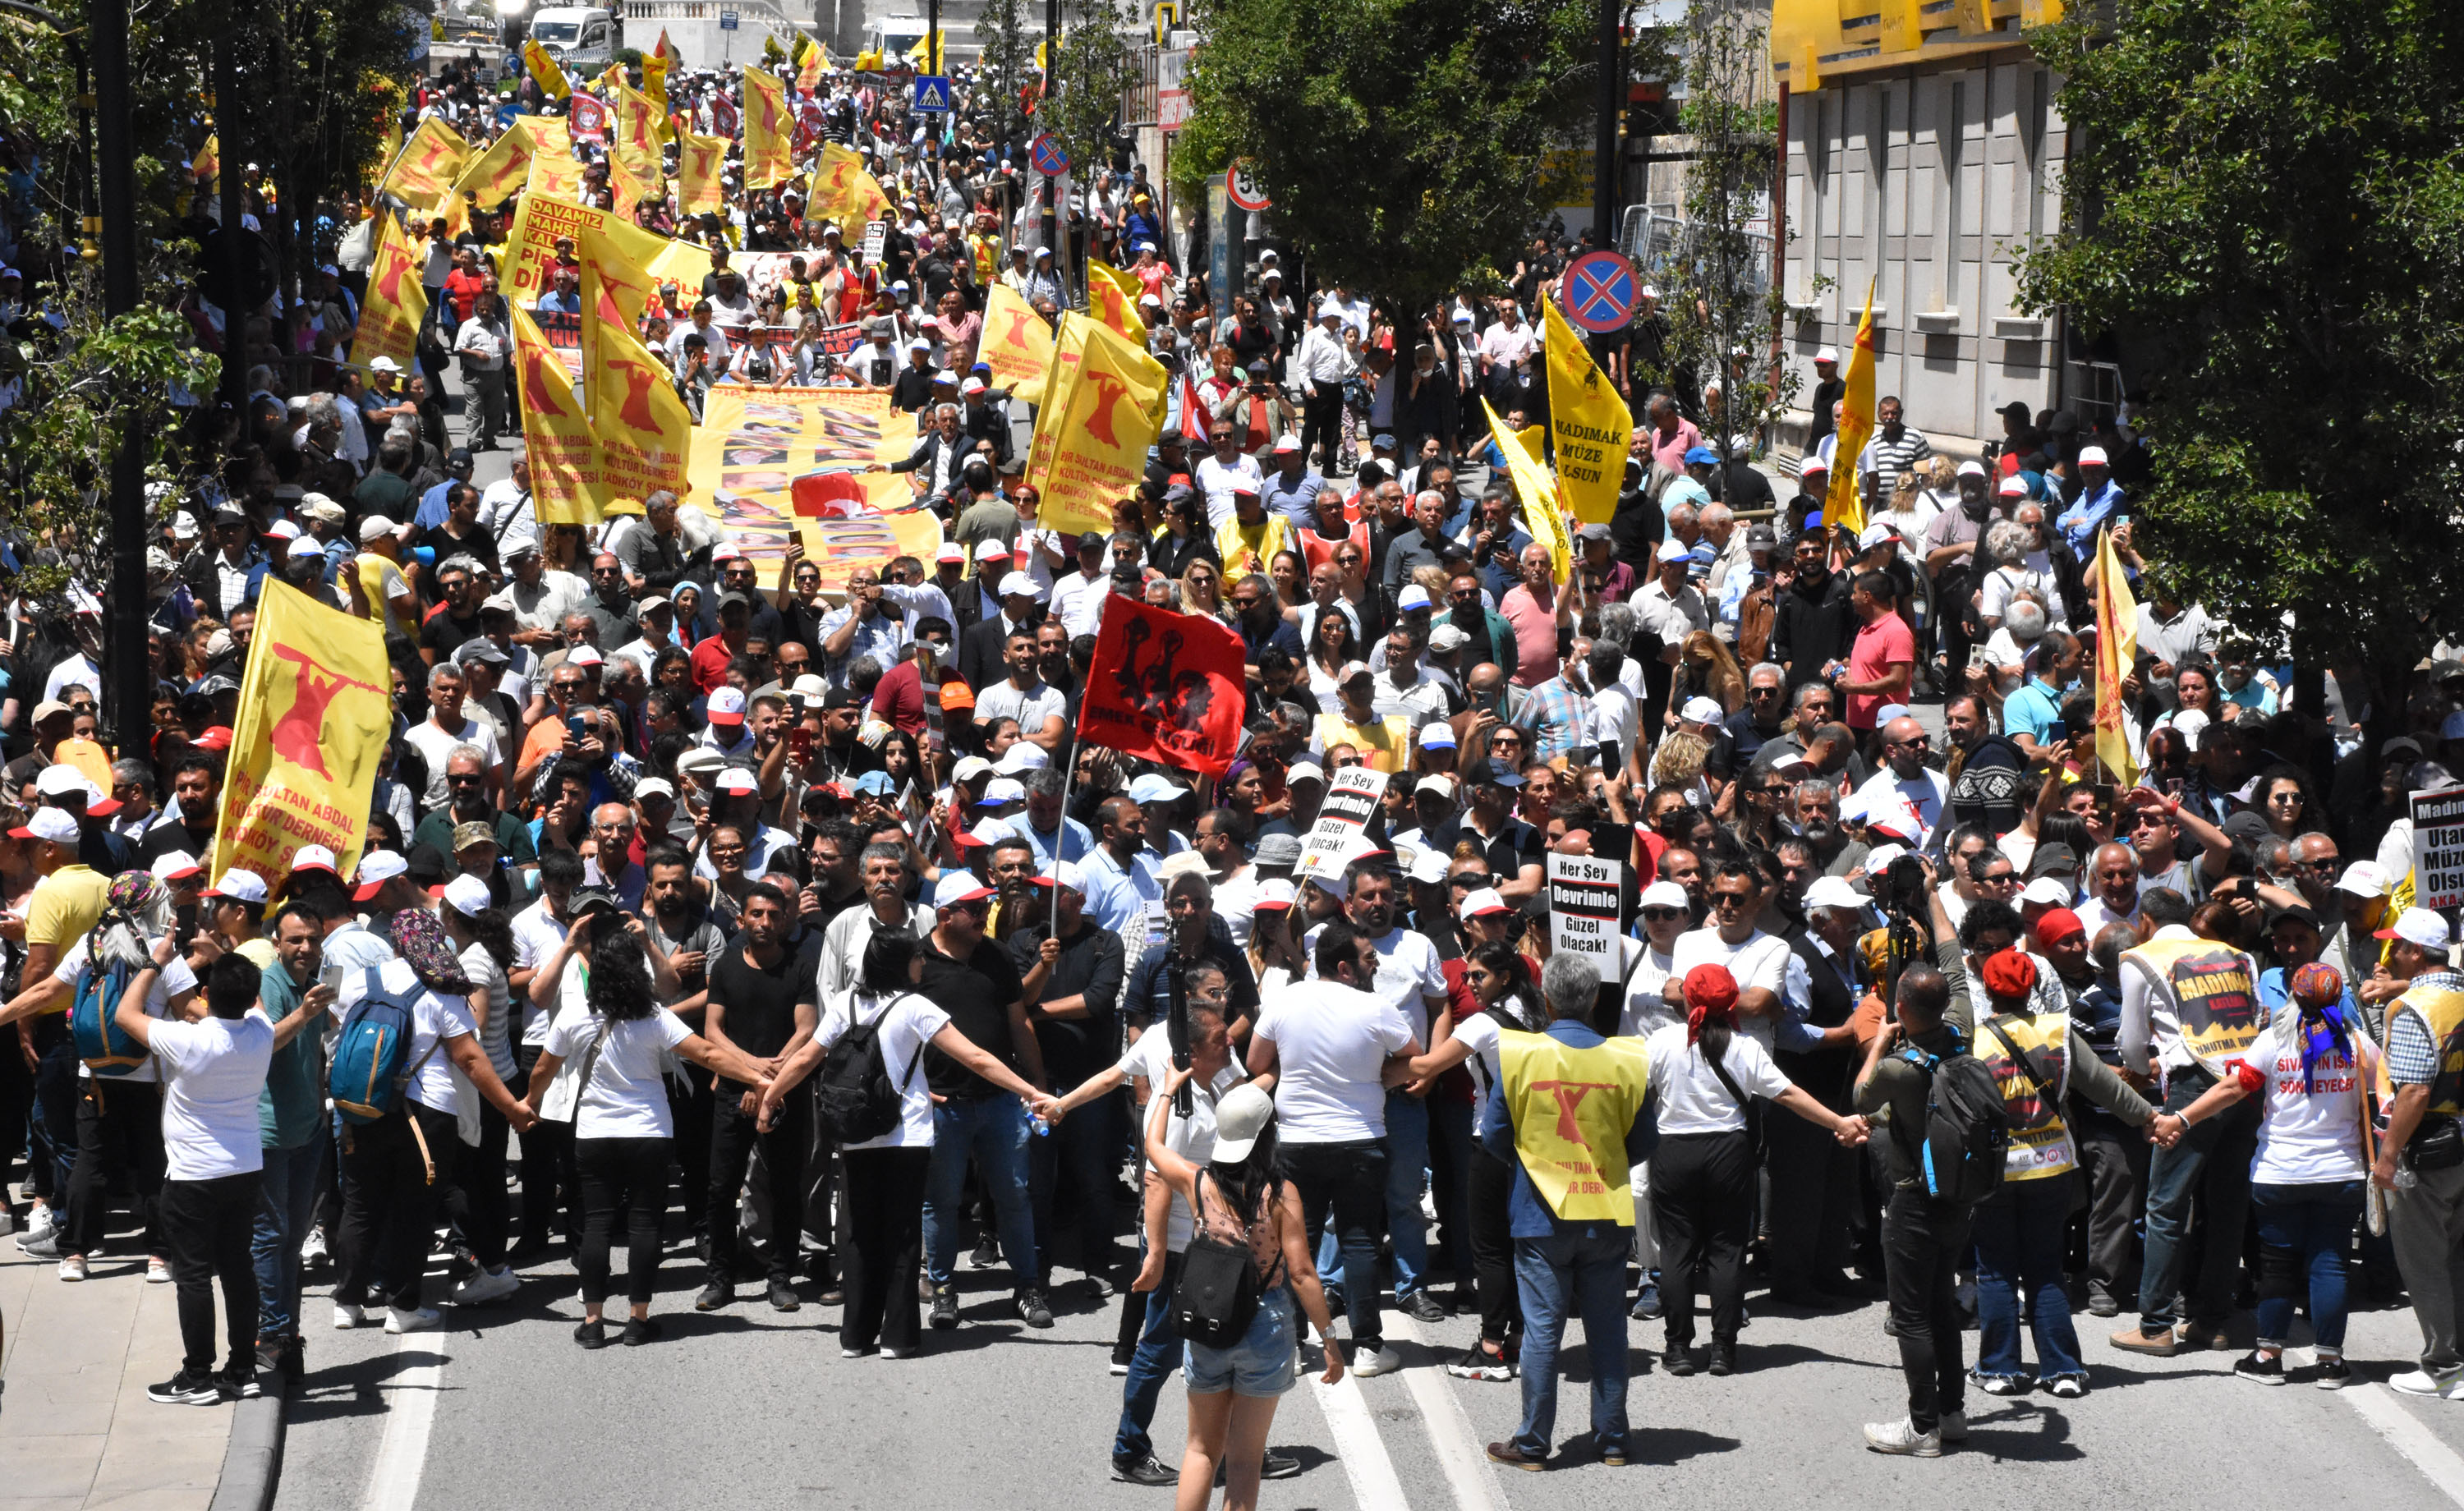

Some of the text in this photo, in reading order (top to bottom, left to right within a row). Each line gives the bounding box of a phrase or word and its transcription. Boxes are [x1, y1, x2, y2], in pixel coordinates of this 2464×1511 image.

[531, 200, 602, 227] DAVAMIZ
[563, 435, 592, 447] ABDAL
[1555, 419, 1623, 445] MADIMAK
[603, 439, 616, 450] PİR
[618, 443, 650, 458] SULTAN
[1561, 443, 1603, 464] MÜZE
[605, 453, 679, 482] KÜLTÜR DERNEĞİ
[1060, 451, 1135, 480] PİR SULTAN ABDAL
[1563, 465, 1602, 484] LSUN
[1050, 481, 1092, 500] KADIKÖY
[1059, 467, 1130, 496] KÜLTÜR DERNEĞİ
[1064, 501, 1109, 523] VE CEMEVİ
[1089, 706, 1135, 727] EMEK
[1352, 774, 1375, 789] Şey
[234, 769, 354, 835] PİR SULTAN ABDAL
[228, 797, 347, 857] KÜLTÜR DERNEĞİ
[1319, 820, 1347, 835] Güzel
[223, 824, 280, 855] ADIKÖY
[1308, 837, 1345, 853] Olacak!
[1560, 861, 1608, 881] Her Şey
[1553, 885, 1617, 908] Devrimle
[2429, 894, 2464, 909] AKA-
[1565, 916, 1600, 934] Güzel
[1561, 935, 1607, 953] Olacak!
[2177, 971, 2252, 1003] MADIMA
[2195, 1037, 2237, 1055] UNUTMA
